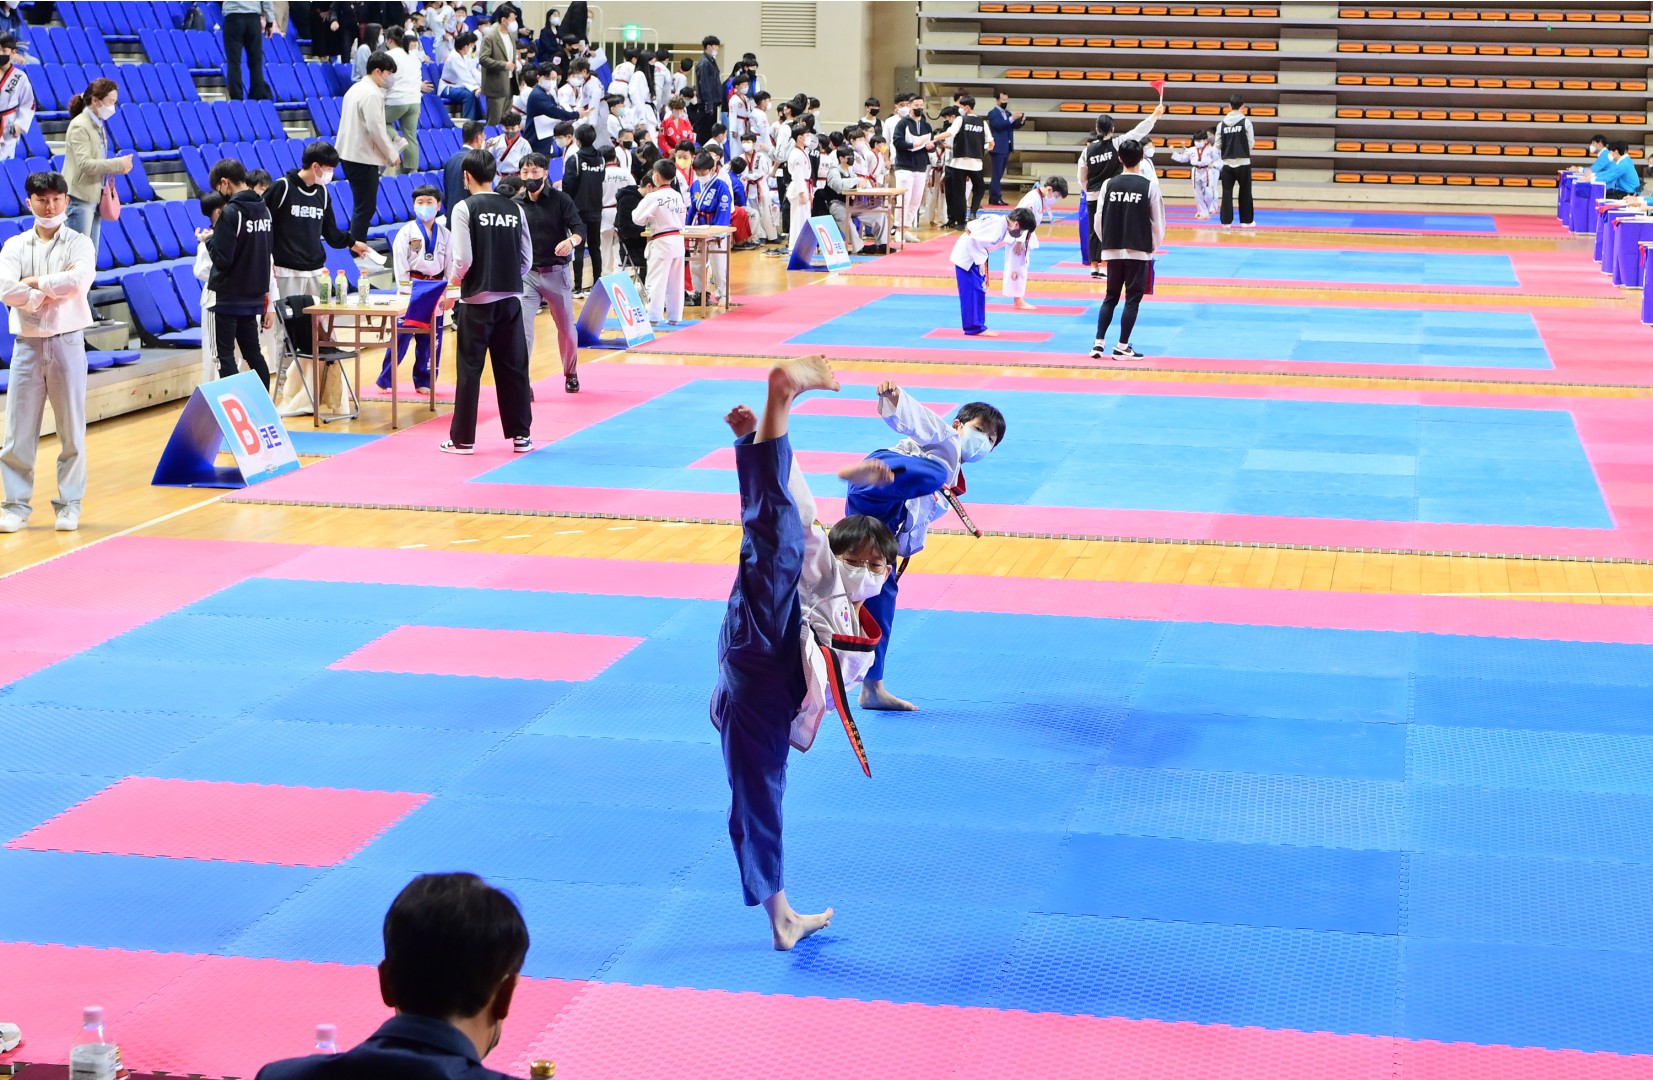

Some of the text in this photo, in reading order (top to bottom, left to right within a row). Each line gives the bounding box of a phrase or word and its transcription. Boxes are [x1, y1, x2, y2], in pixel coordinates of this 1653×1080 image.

[964, 123, 983, 132] STAFF
[1224, 125, 1242, 133] STAFF
[1090, 151, 1113, 165] STAFF
[1110, 191, 1142, 204] STAFF
[291, 204, 324, 220] 해운대구
[246, 219, 272, 233] STAFF
[478, 212, 519, 228] STAFF
[817, 226, 834, 256] D
[613, 285, 645, 327] C 코트
[220, 397, 283, 456] B 코트
